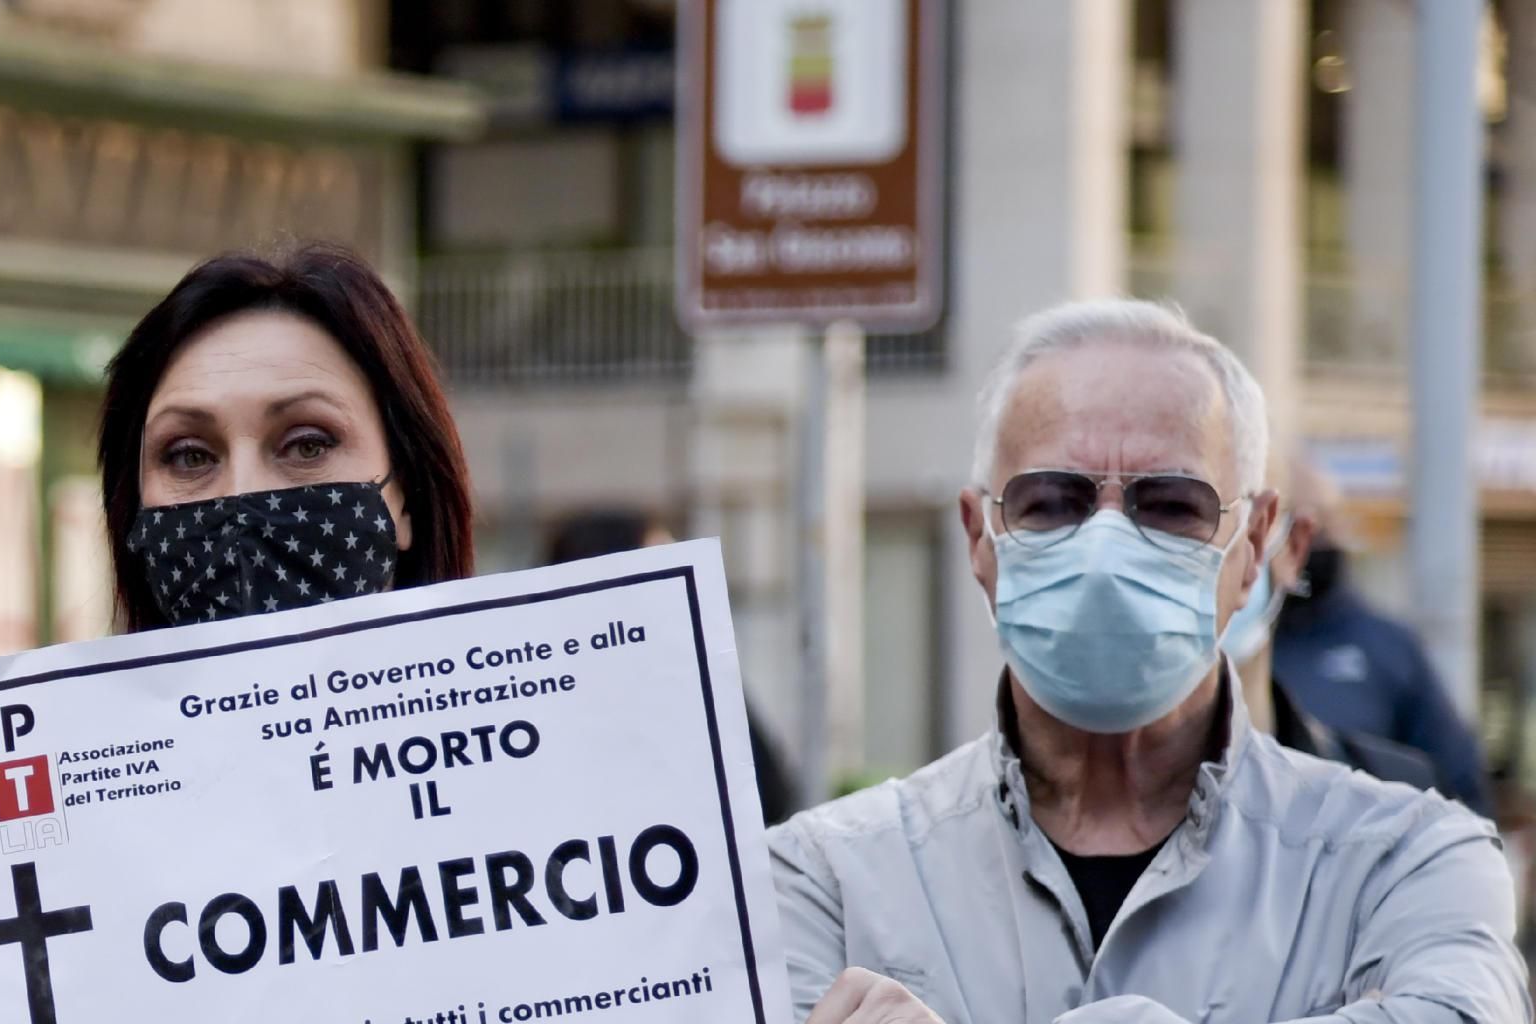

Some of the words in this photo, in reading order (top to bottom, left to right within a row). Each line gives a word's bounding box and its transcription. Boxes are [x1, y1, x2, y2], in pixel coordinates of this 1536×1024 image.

[179, 683, 280, 718] Grazie
[290, 674, 318, 700] al
[327, 658, 456, 694] Governo
[466, 639, 553, 670] Conte
[563, 637, 580, 655] e
[590, 620, 646, 650] alla
[261, 717, 313, 740] sua
[323, 672, 576, 730] Amministrazione
[59, 737, 174, 764] Associazione
[62, 762, 121, 785] Partite
[126, 759, 160, 776] IVA
[352, 719, 540, 784] MORTO
[65, 790, 91, 807] del
[95, 779, 182, 801] Territorio
[409, 780, 451, 820] IL
[143, 823, 699, 983] COMMERCIO
[498, 967, 713, 1024] commercianti
